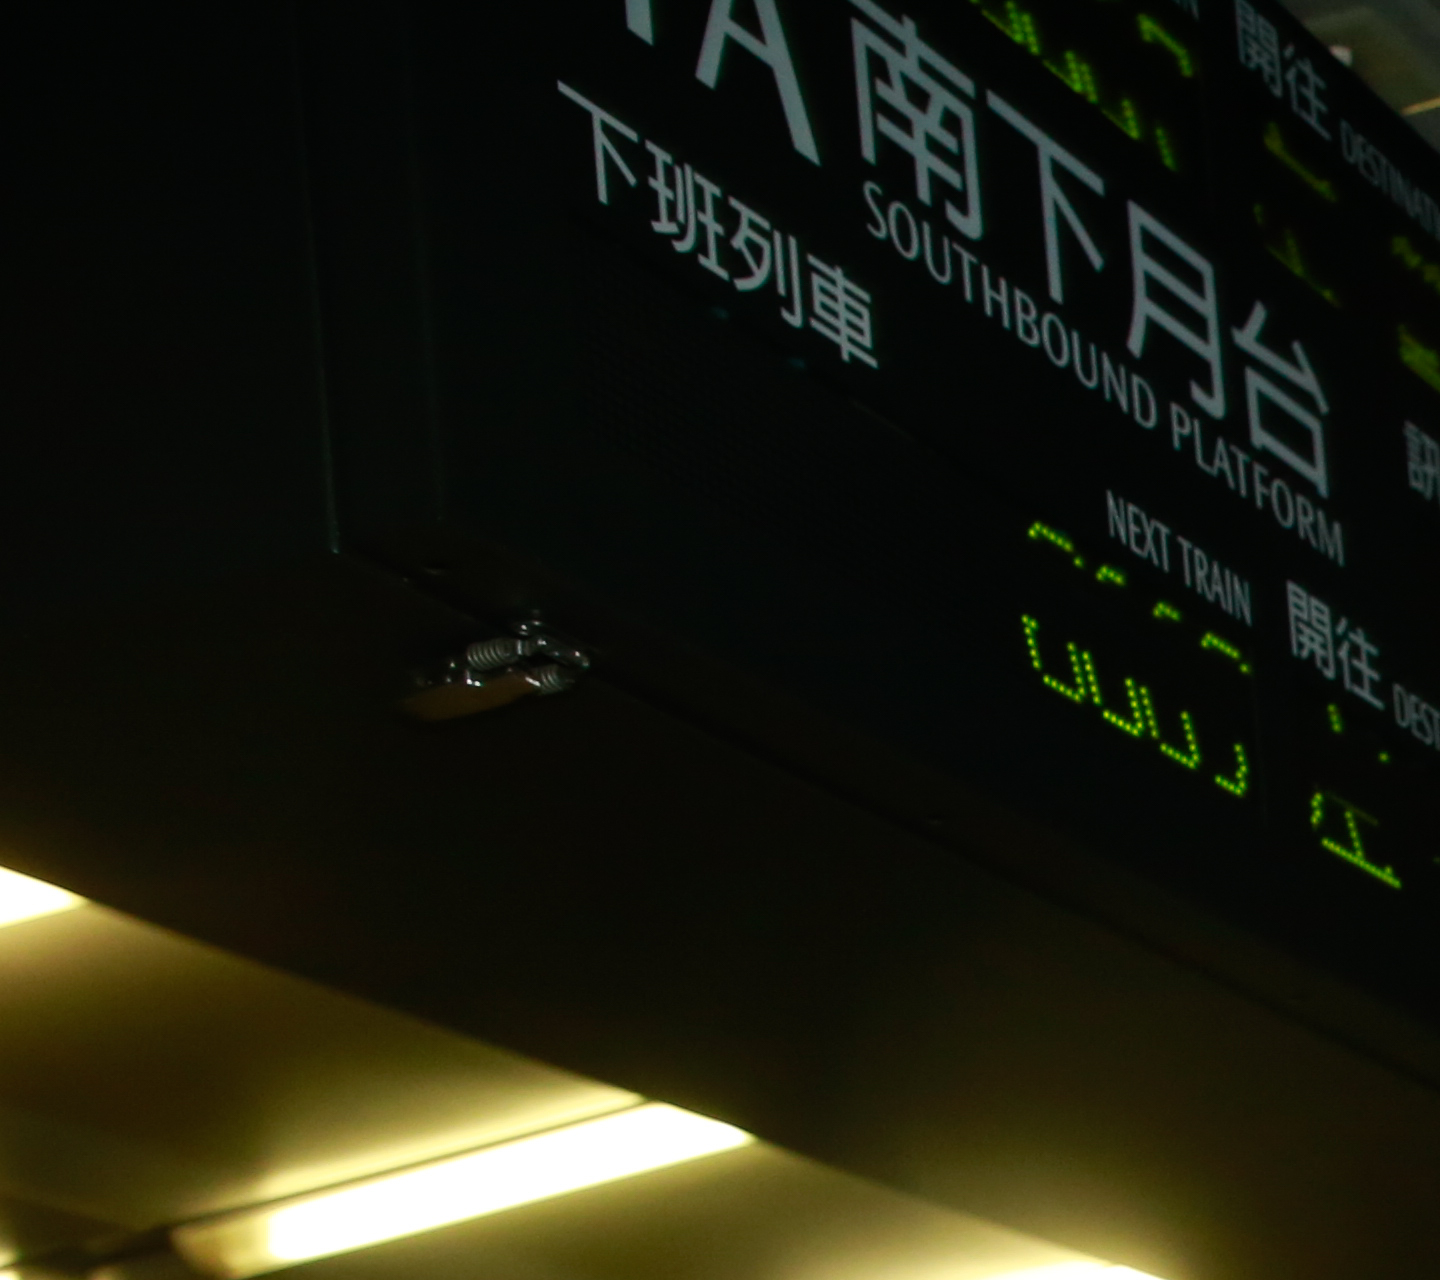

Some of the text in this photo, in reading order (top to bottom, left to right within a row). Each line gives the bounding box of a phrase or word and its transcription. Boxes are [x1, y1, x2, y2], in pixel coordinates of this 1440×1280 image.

[1234, 0, 1333, 142] 開往
[556, 79, 879, 370] 下班列車
[845, 0, 1330, 498] 南下月台
[861, 180, 1158, 431] SOUTHBOUND
[1170, 401, 1346, 567] PLATFORM
[1105, 489, 1254, 627] NEXT TRAIN
[1285, 579, 1386, 712] 開往
